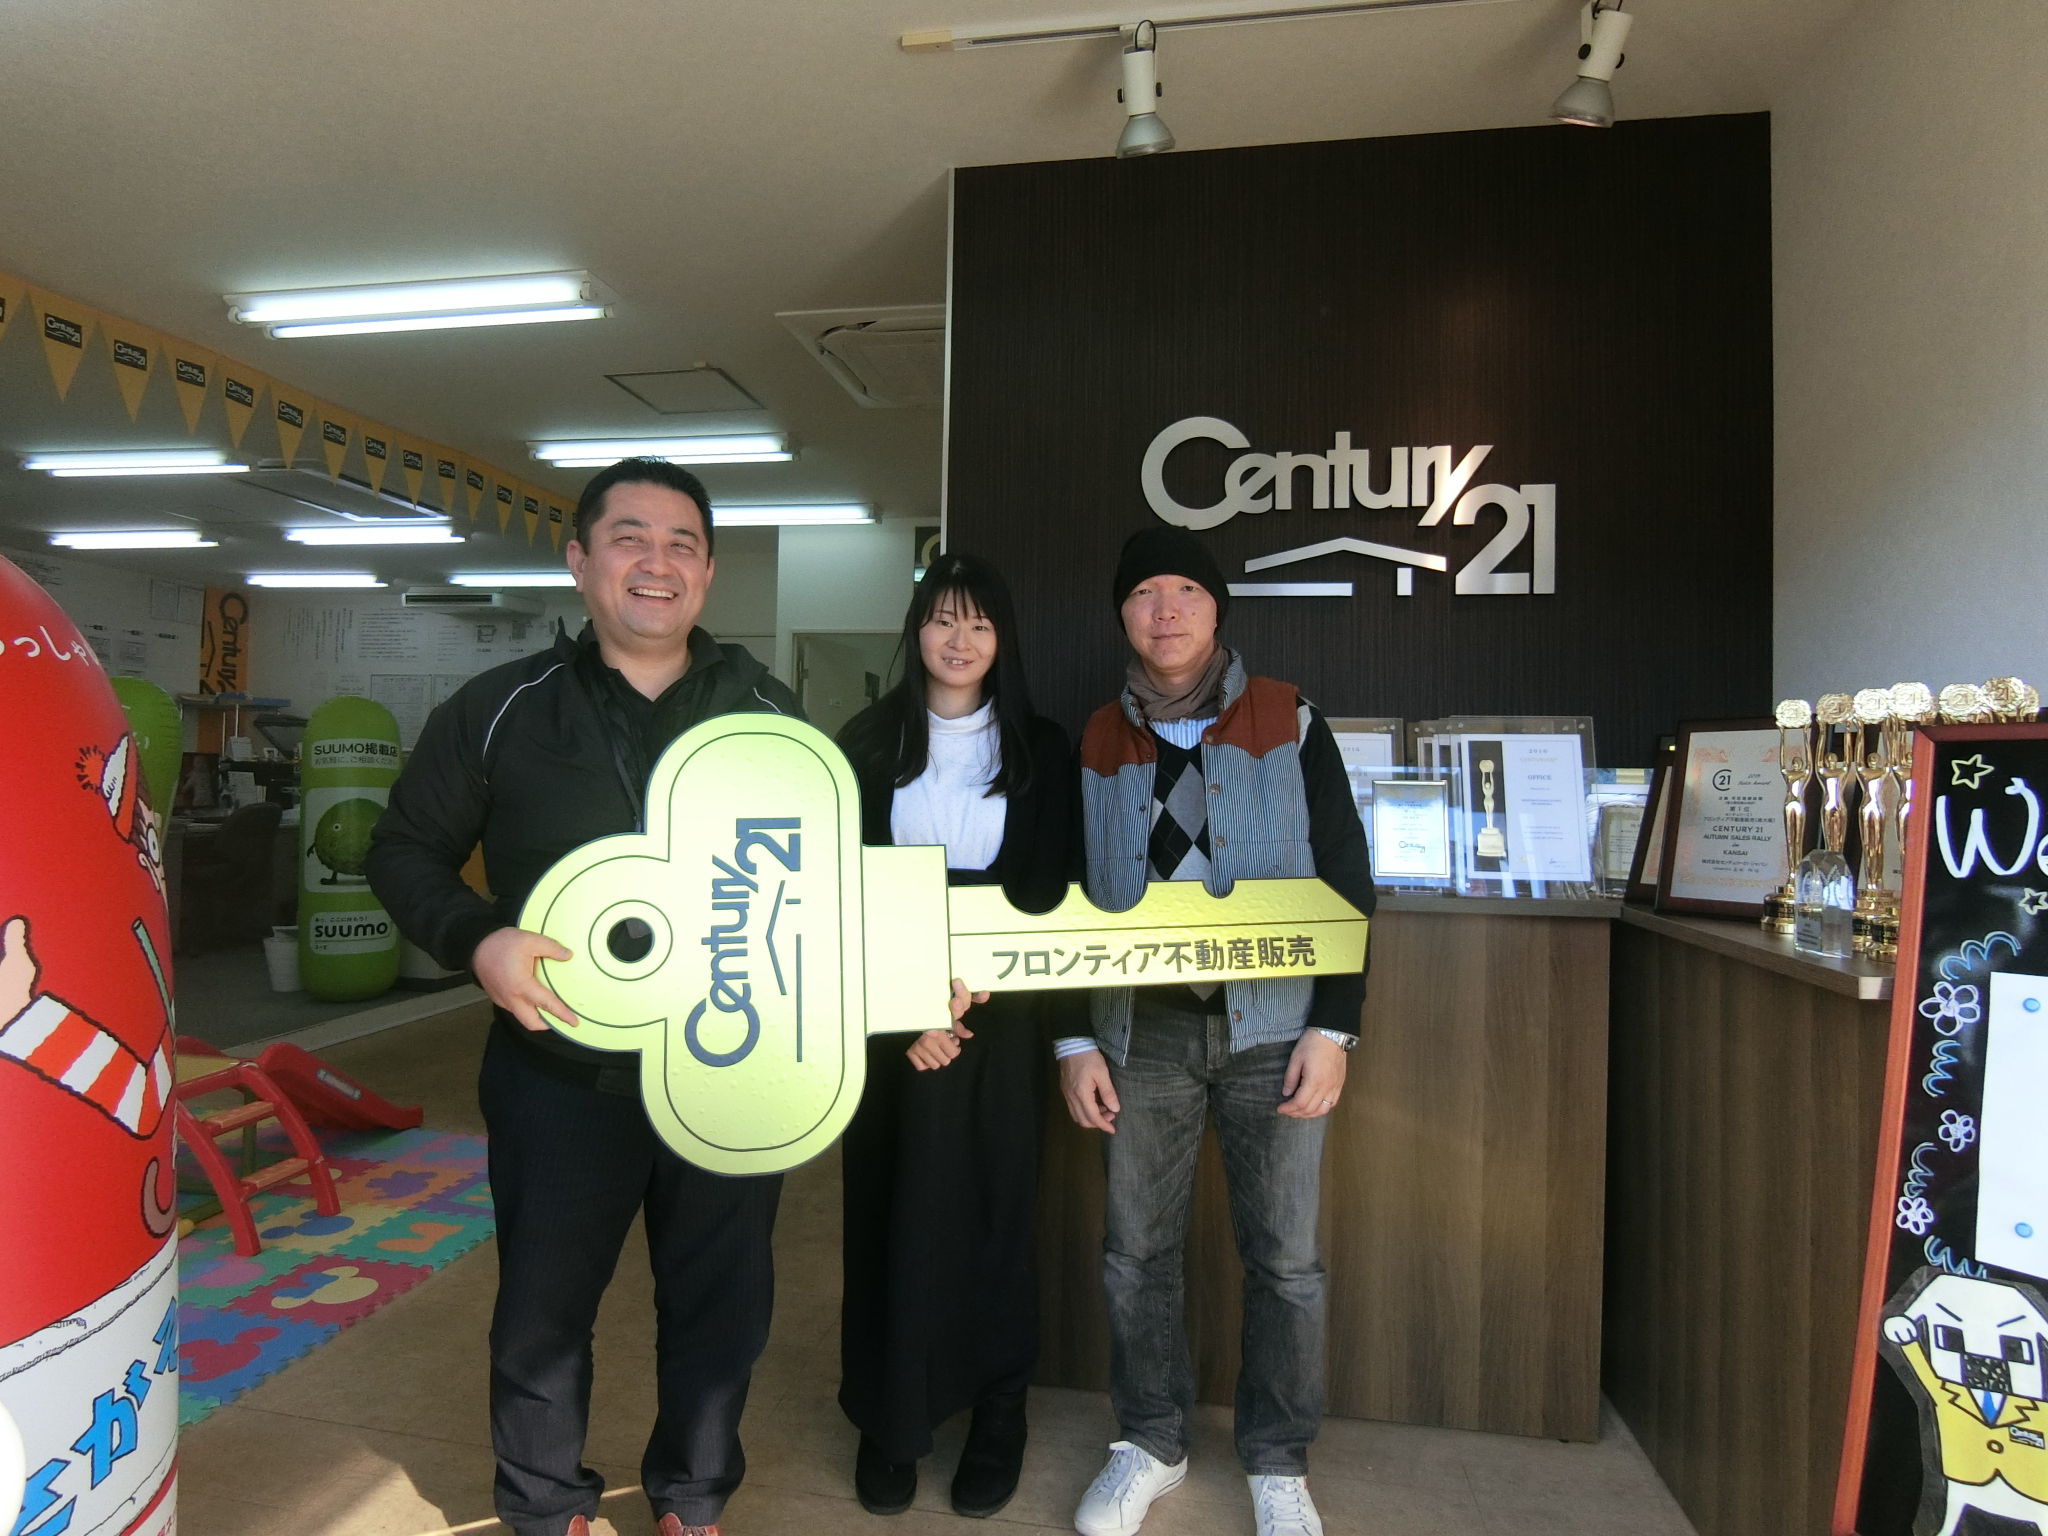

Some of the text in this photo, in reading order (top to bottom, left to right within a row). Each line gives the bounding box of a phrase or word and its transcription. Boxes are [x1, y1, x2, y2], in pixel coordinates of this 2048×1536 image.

[46, 316, 76, 334] Century
[1141, 416, 1557, 595] Century 21
[219, 592, 249, 691] Century
[314, 742, 398, 758] SUUMO掲載店
[1712, 825, 1753, 833] CENTURY
[684, 817, 801, 1067] Century 21
[992, 934, 1317, 980] フロンティア不動産販売
